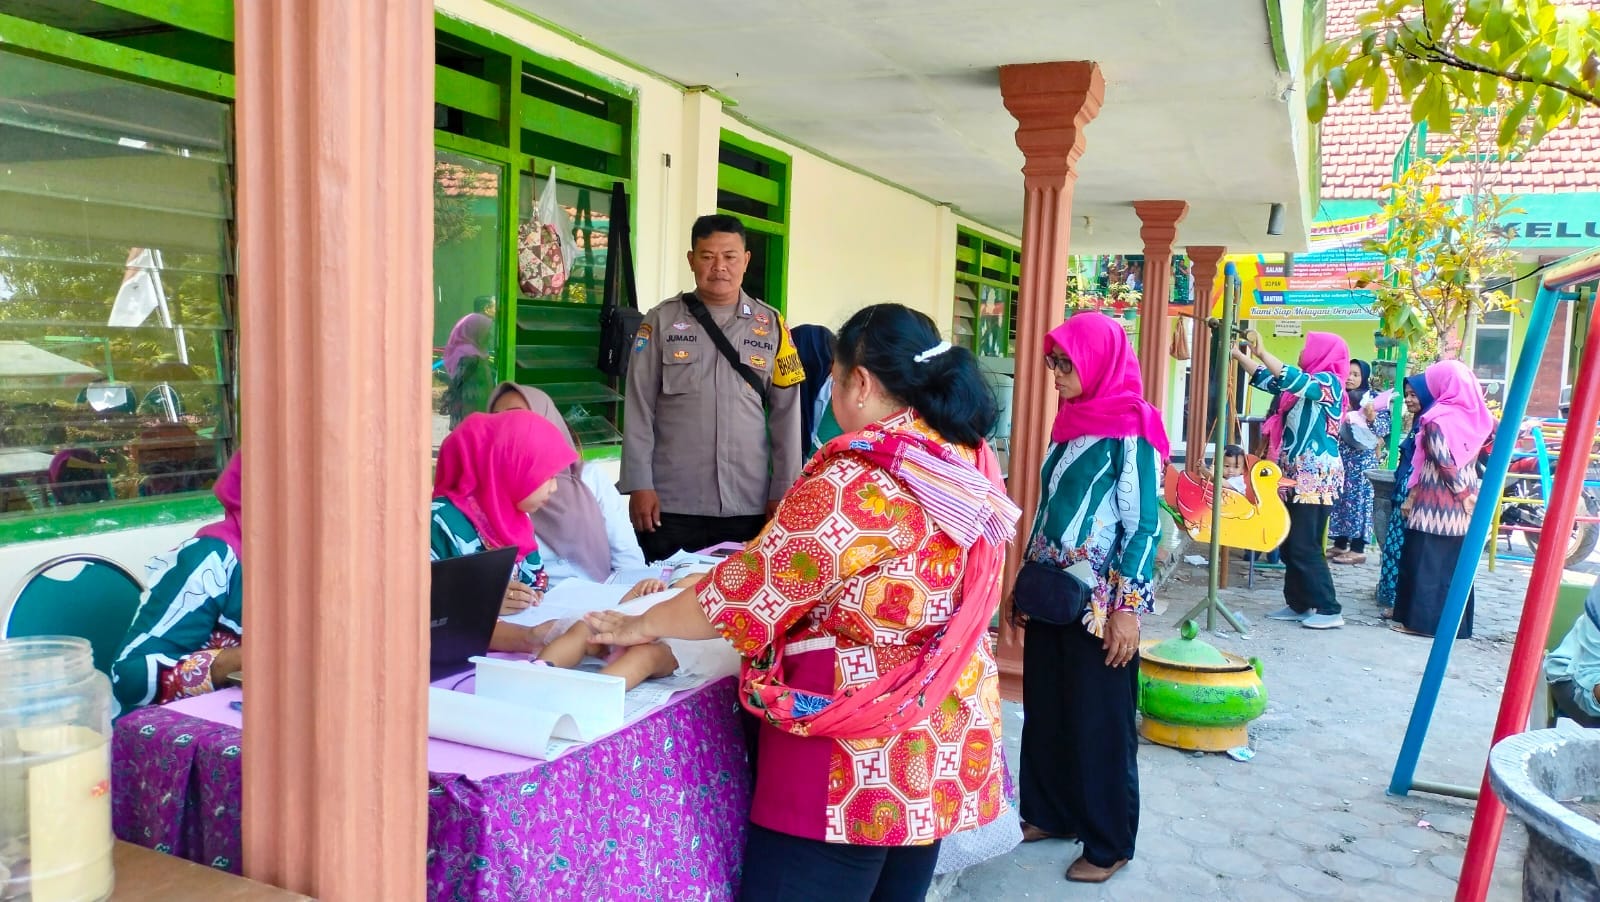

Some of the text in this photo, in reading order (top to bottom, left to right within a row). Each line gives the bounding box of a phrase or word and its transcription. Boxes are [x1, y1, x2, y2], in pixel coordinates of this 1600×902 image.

[1250, 307, 1271, 315] Kami
[1274, 307, 1292, 316] Siap
[1294, 307, 1330, 316] Melayani
[1332, 307, 1362, 316] Dengan
[666, 335, 697, 343] JUMADI
[743, 338, 773, 351] POLRI
